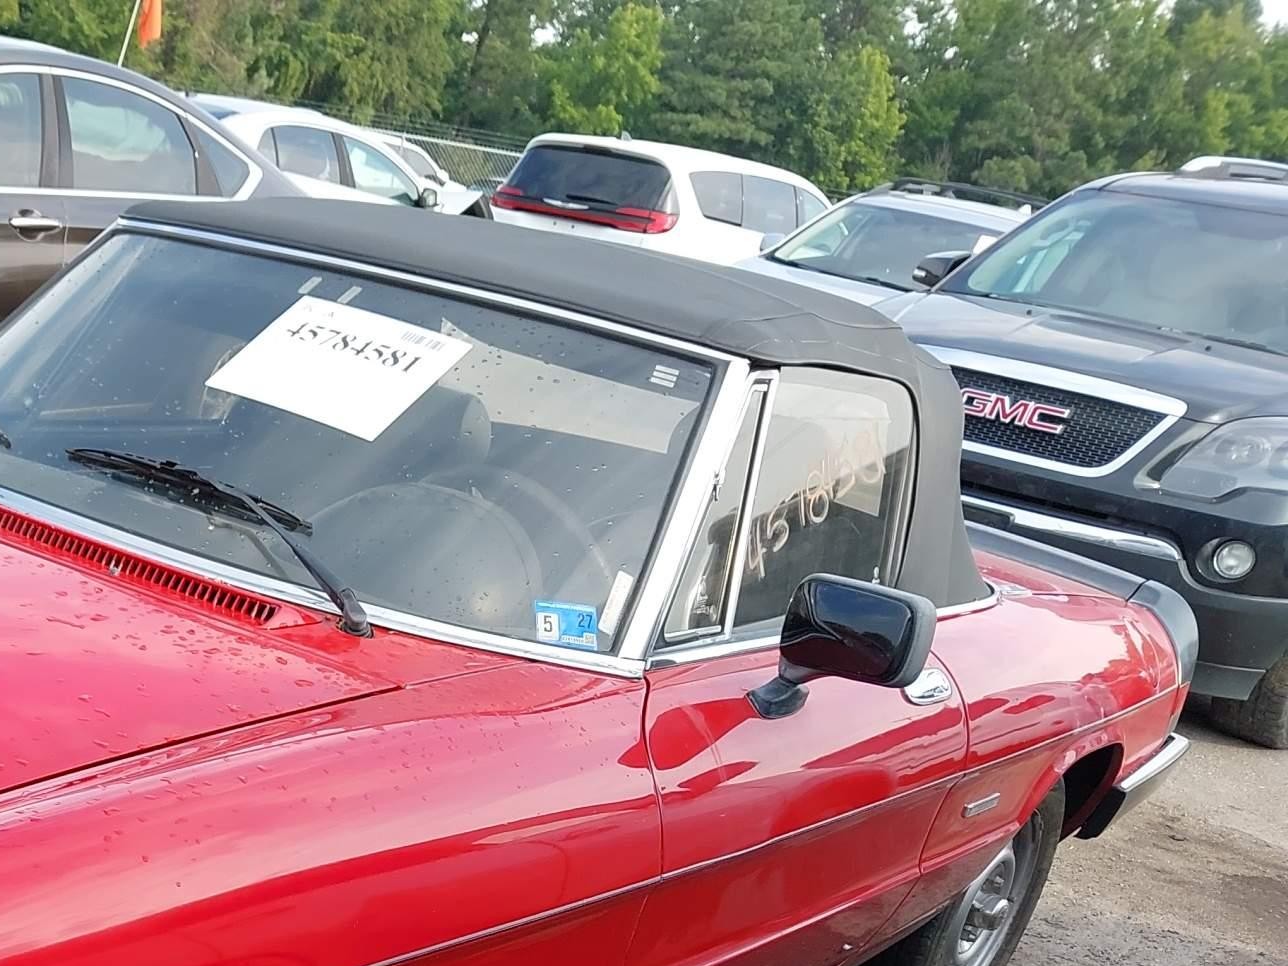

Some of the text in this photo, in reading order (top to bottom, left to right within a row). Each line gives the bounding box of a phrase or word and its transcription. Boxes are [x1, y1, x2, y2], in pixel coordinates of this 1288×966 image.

[286, 322, 422, 373] 45784581
[960, 387, 1070, 434] GMC
[543, 613, 593, 633] 5 27
